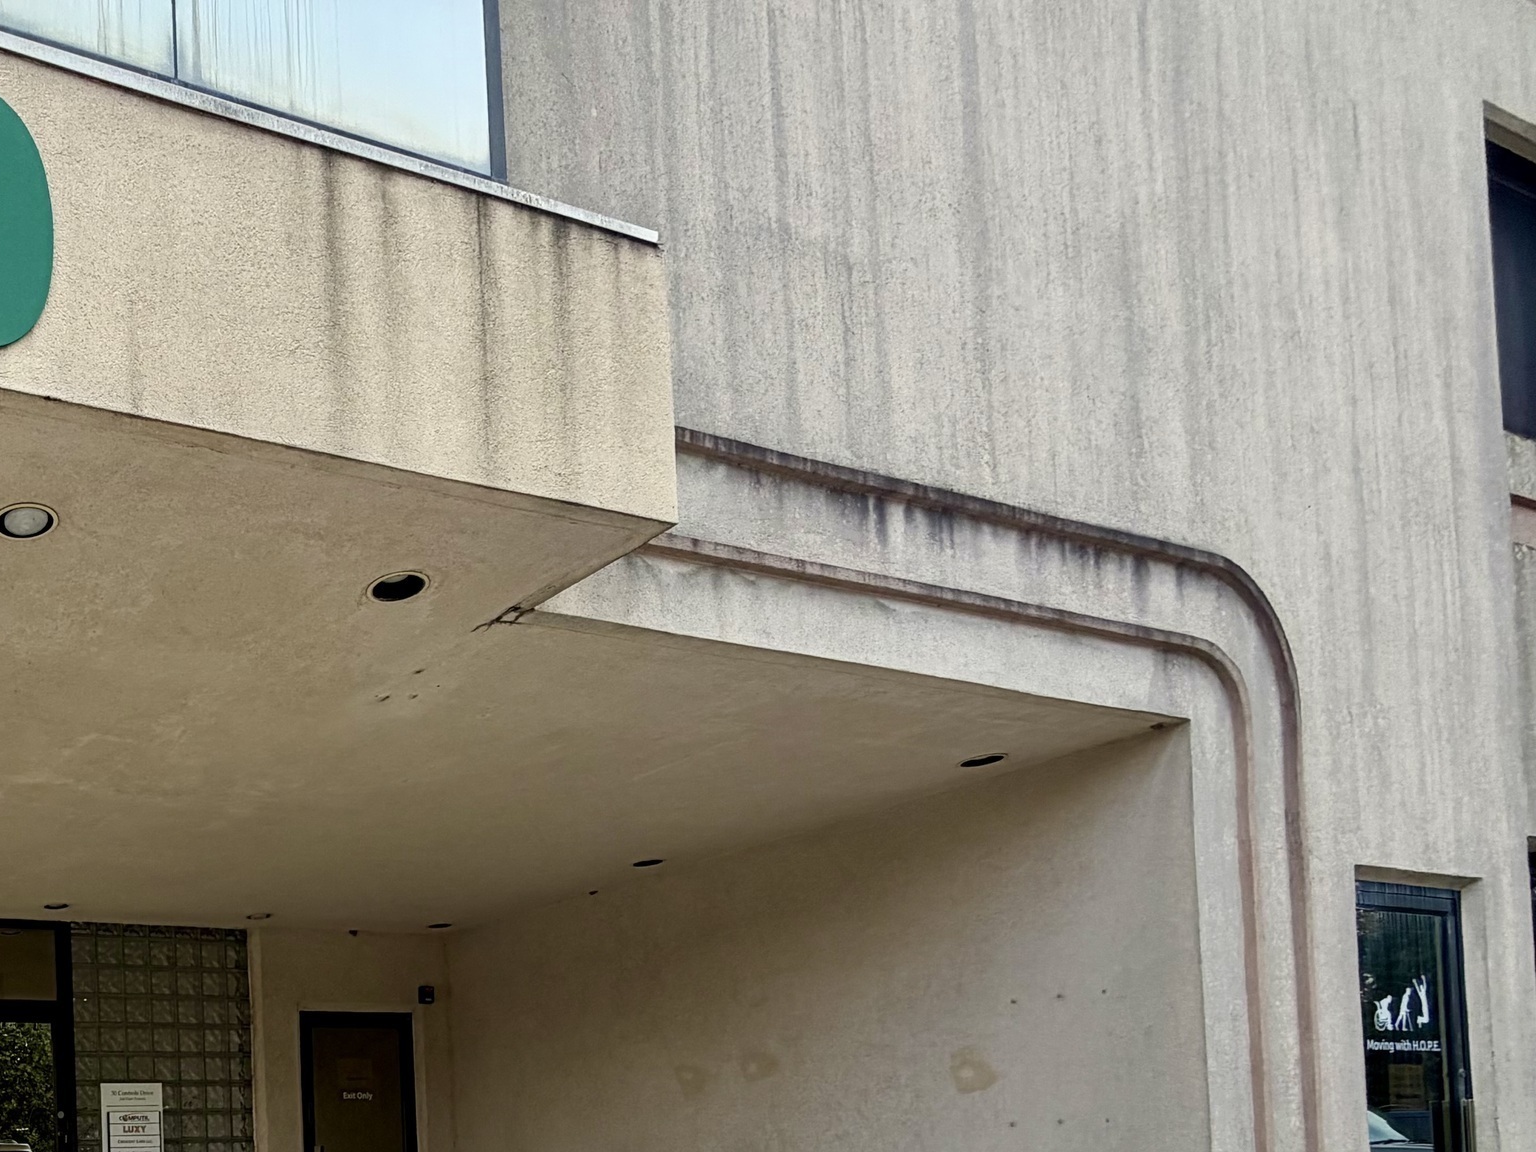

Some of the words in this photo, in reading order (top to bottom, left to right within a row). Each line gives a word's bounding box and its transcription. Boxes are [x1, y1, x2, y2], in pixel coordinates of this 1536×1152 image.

[1367, 1039, 1395, 1053] Moving
[1395, 1039, 1412, 1051] with
[343, 1091, 356, 1100] Exit
[356, 1091, 373, 1101] Only
[123, 1125, 146, 1133] LUXY
